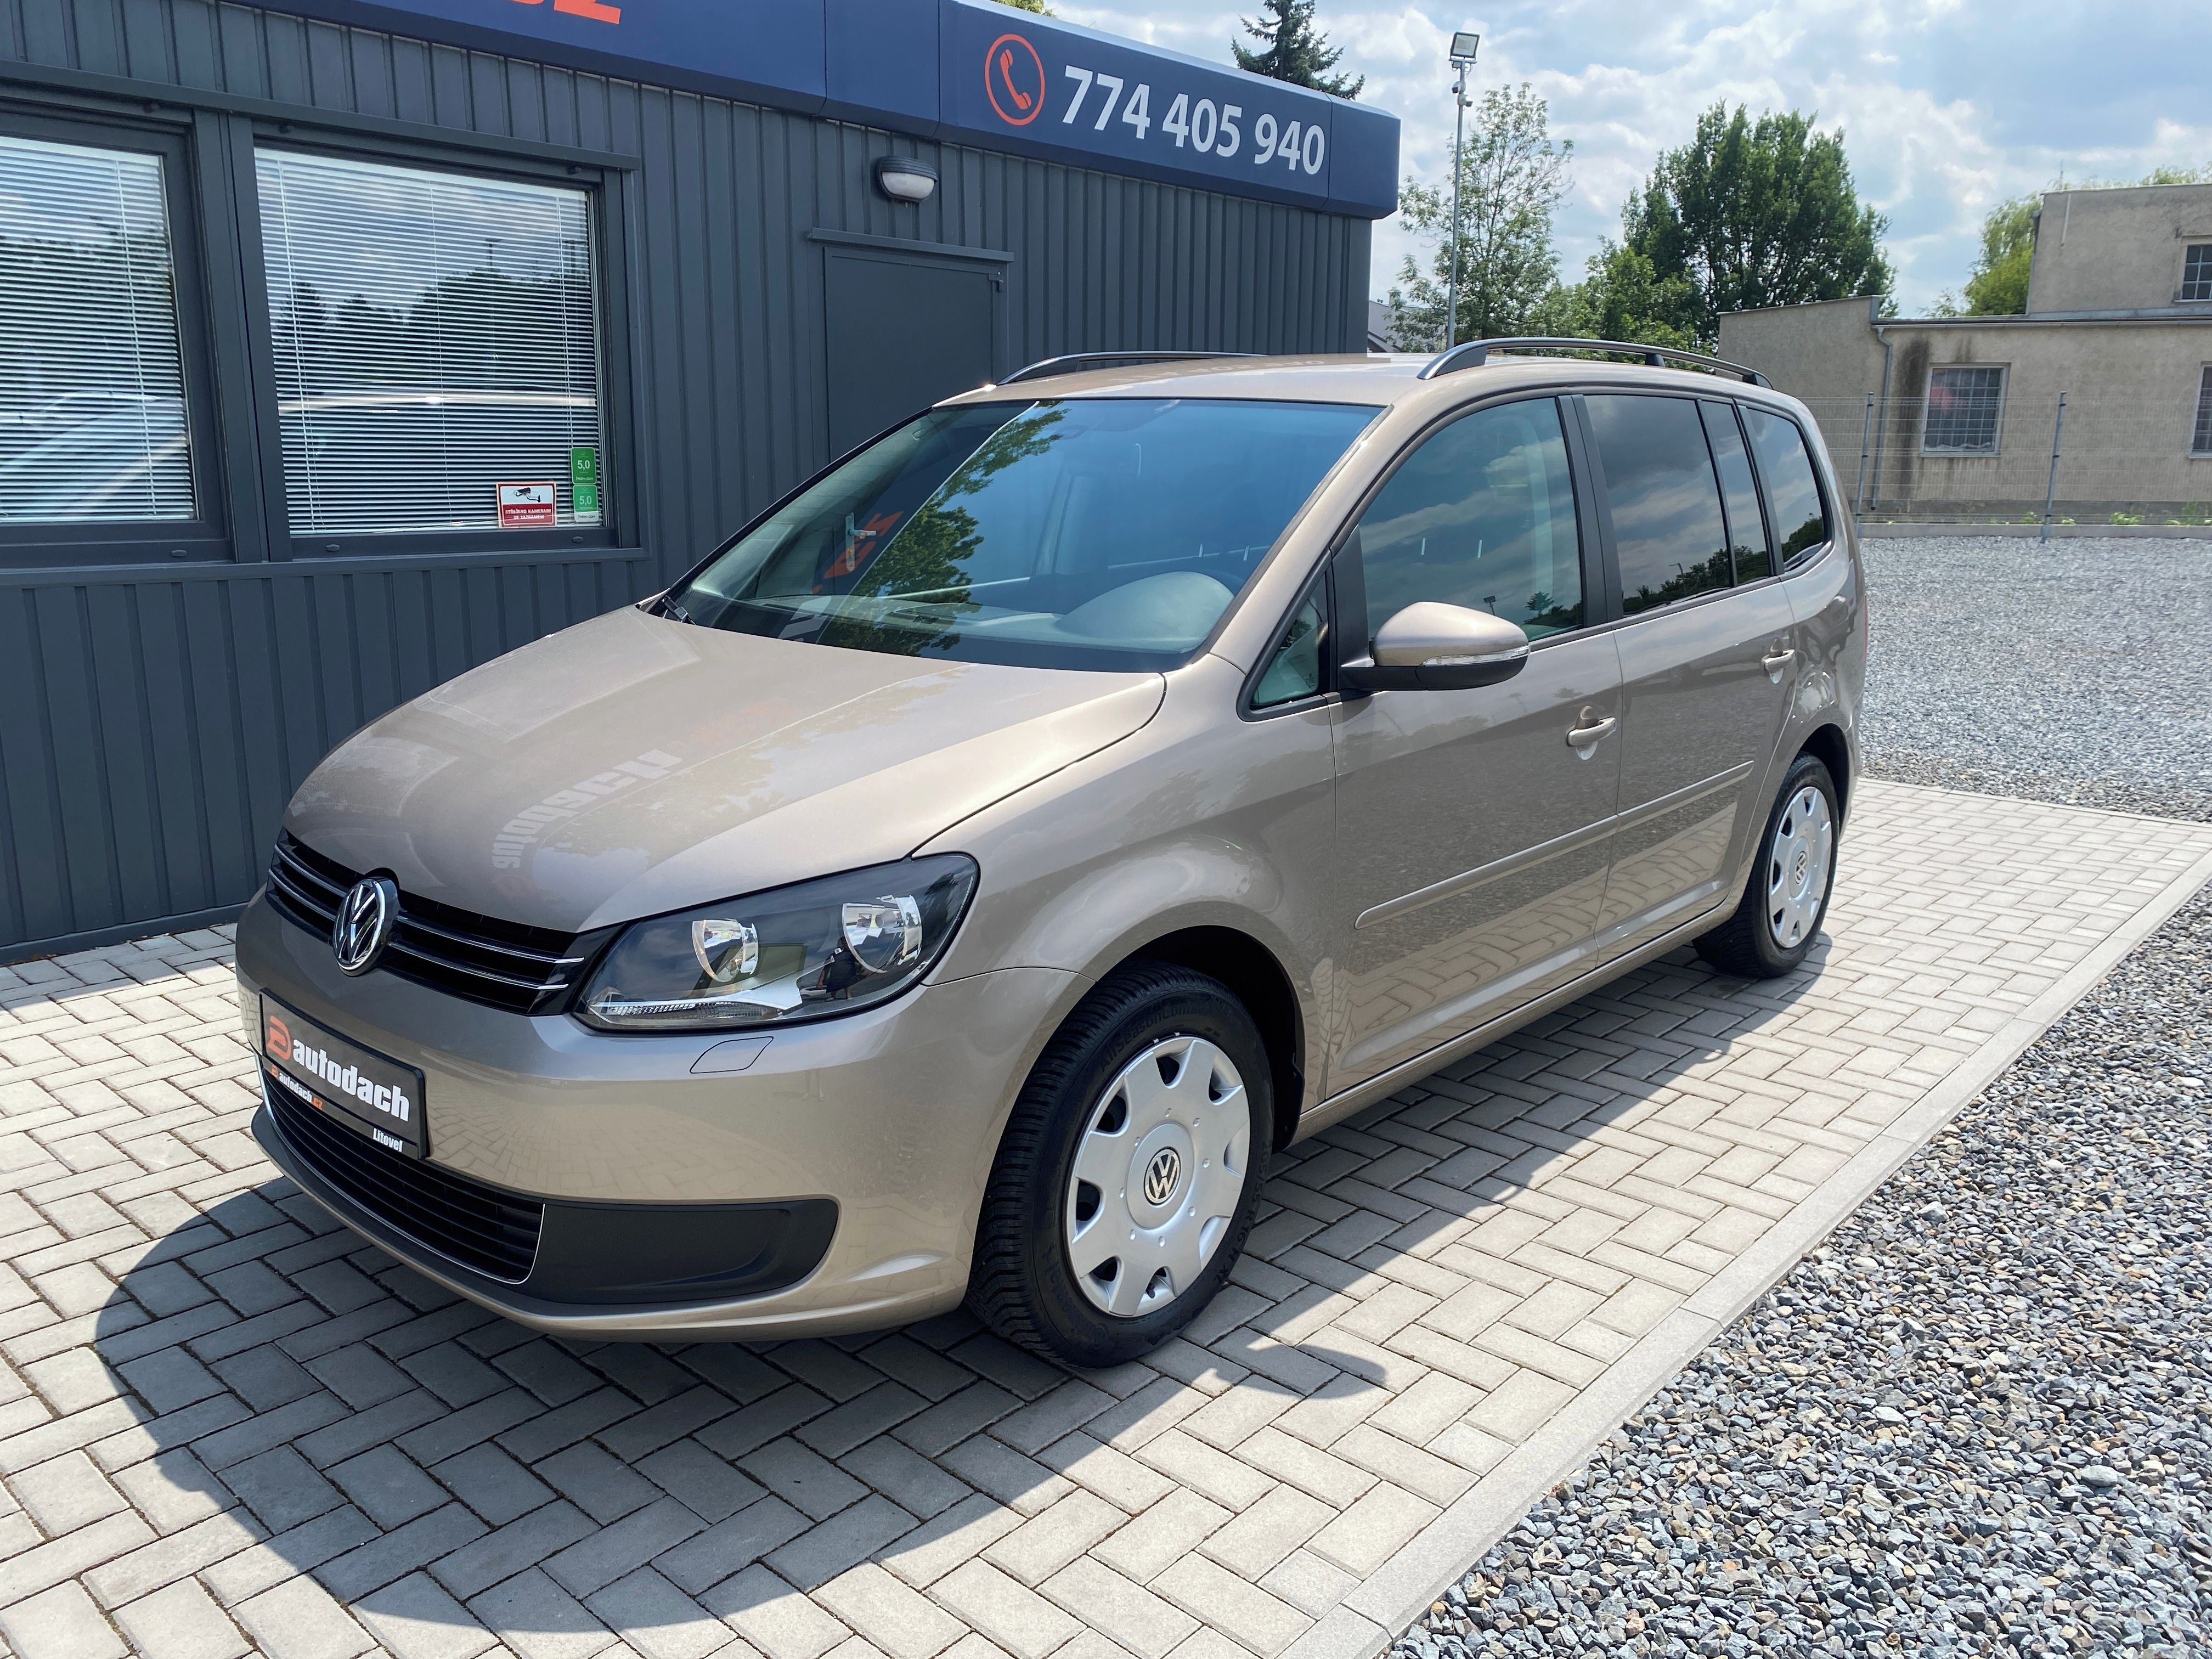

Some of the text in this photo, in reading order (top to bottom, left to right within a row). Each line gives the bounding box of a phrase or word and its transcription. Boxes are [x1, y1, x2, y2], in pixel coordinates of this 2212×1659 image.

[1062, 65, 1325, 175] 774 405 940
[578, 460, 590, 470] 5,0
[579, 496, 592, 505] 5,0
[292, 1039, 410, 1122] autodach
[373, 1127, 403, 1153] Litovel
